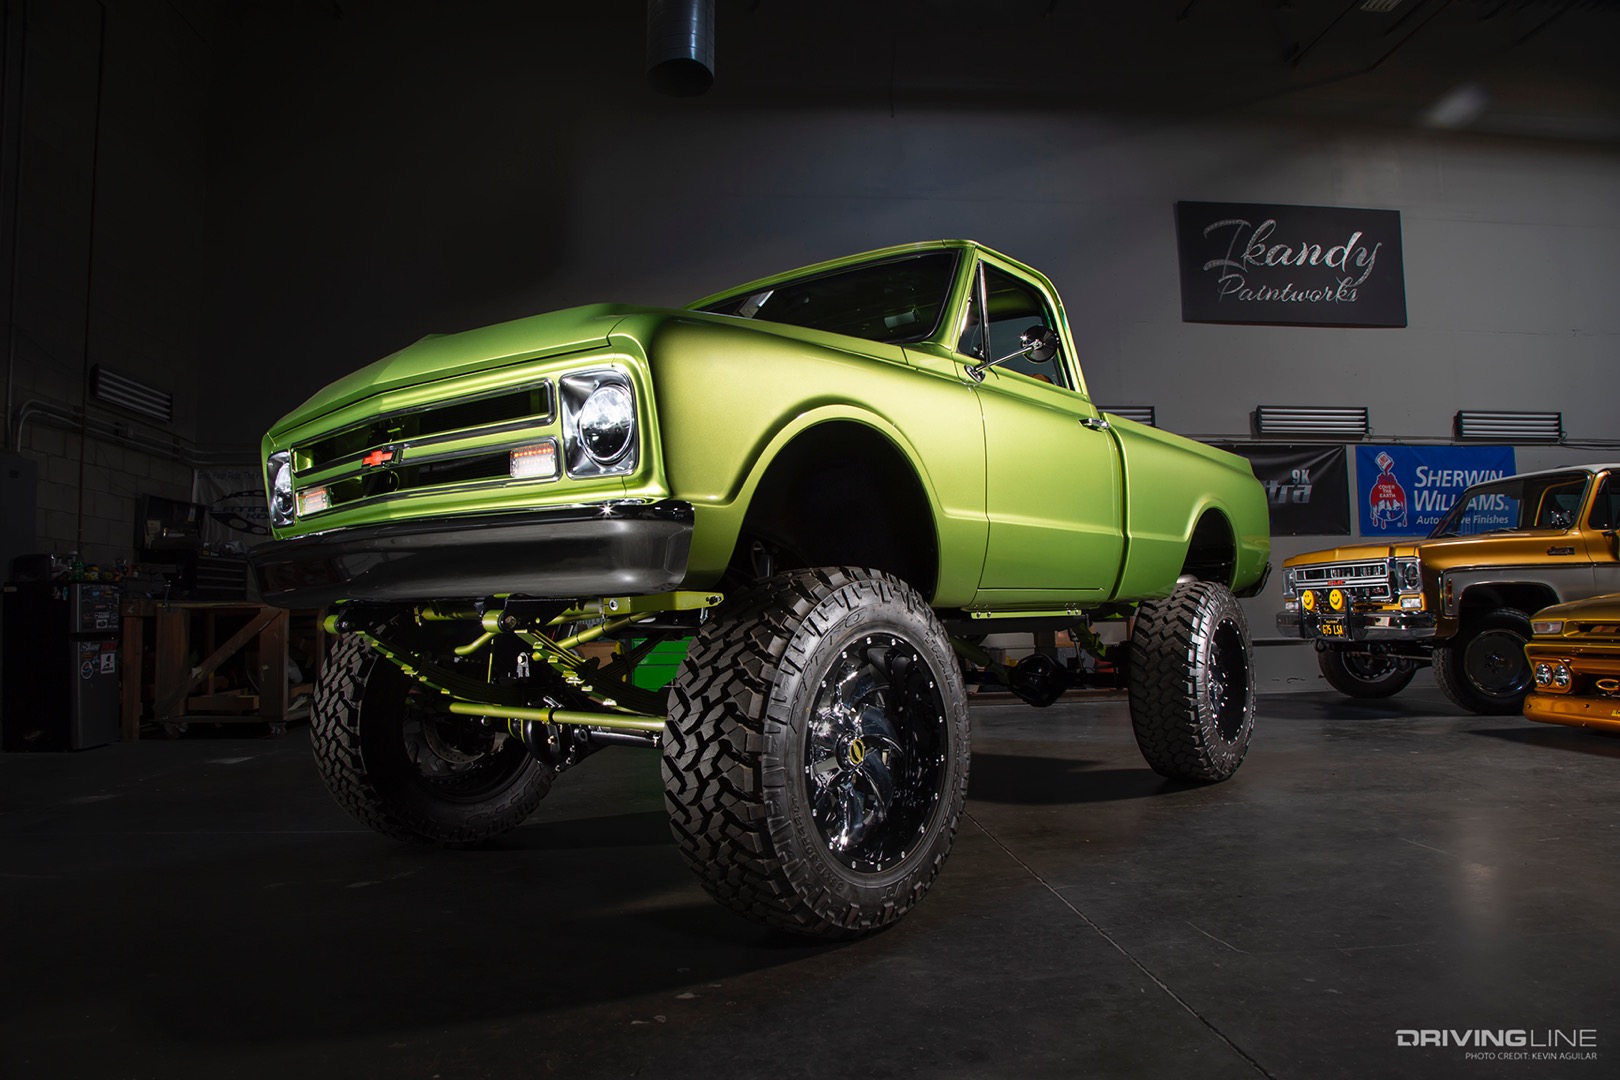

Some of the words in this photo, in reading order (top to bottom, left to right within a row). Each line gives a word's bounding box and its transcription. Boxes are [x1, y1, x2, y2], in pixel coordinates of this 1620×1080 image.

[1203, 218, 1383, 288] Ikandy
[1217, 273, 1359, 304] Paintworks
[1291, 469, 1310, 484] 9K
[1414, 466, 1503, 488] SHERWIN
[1473, 514, 1509, 525] Finishes
